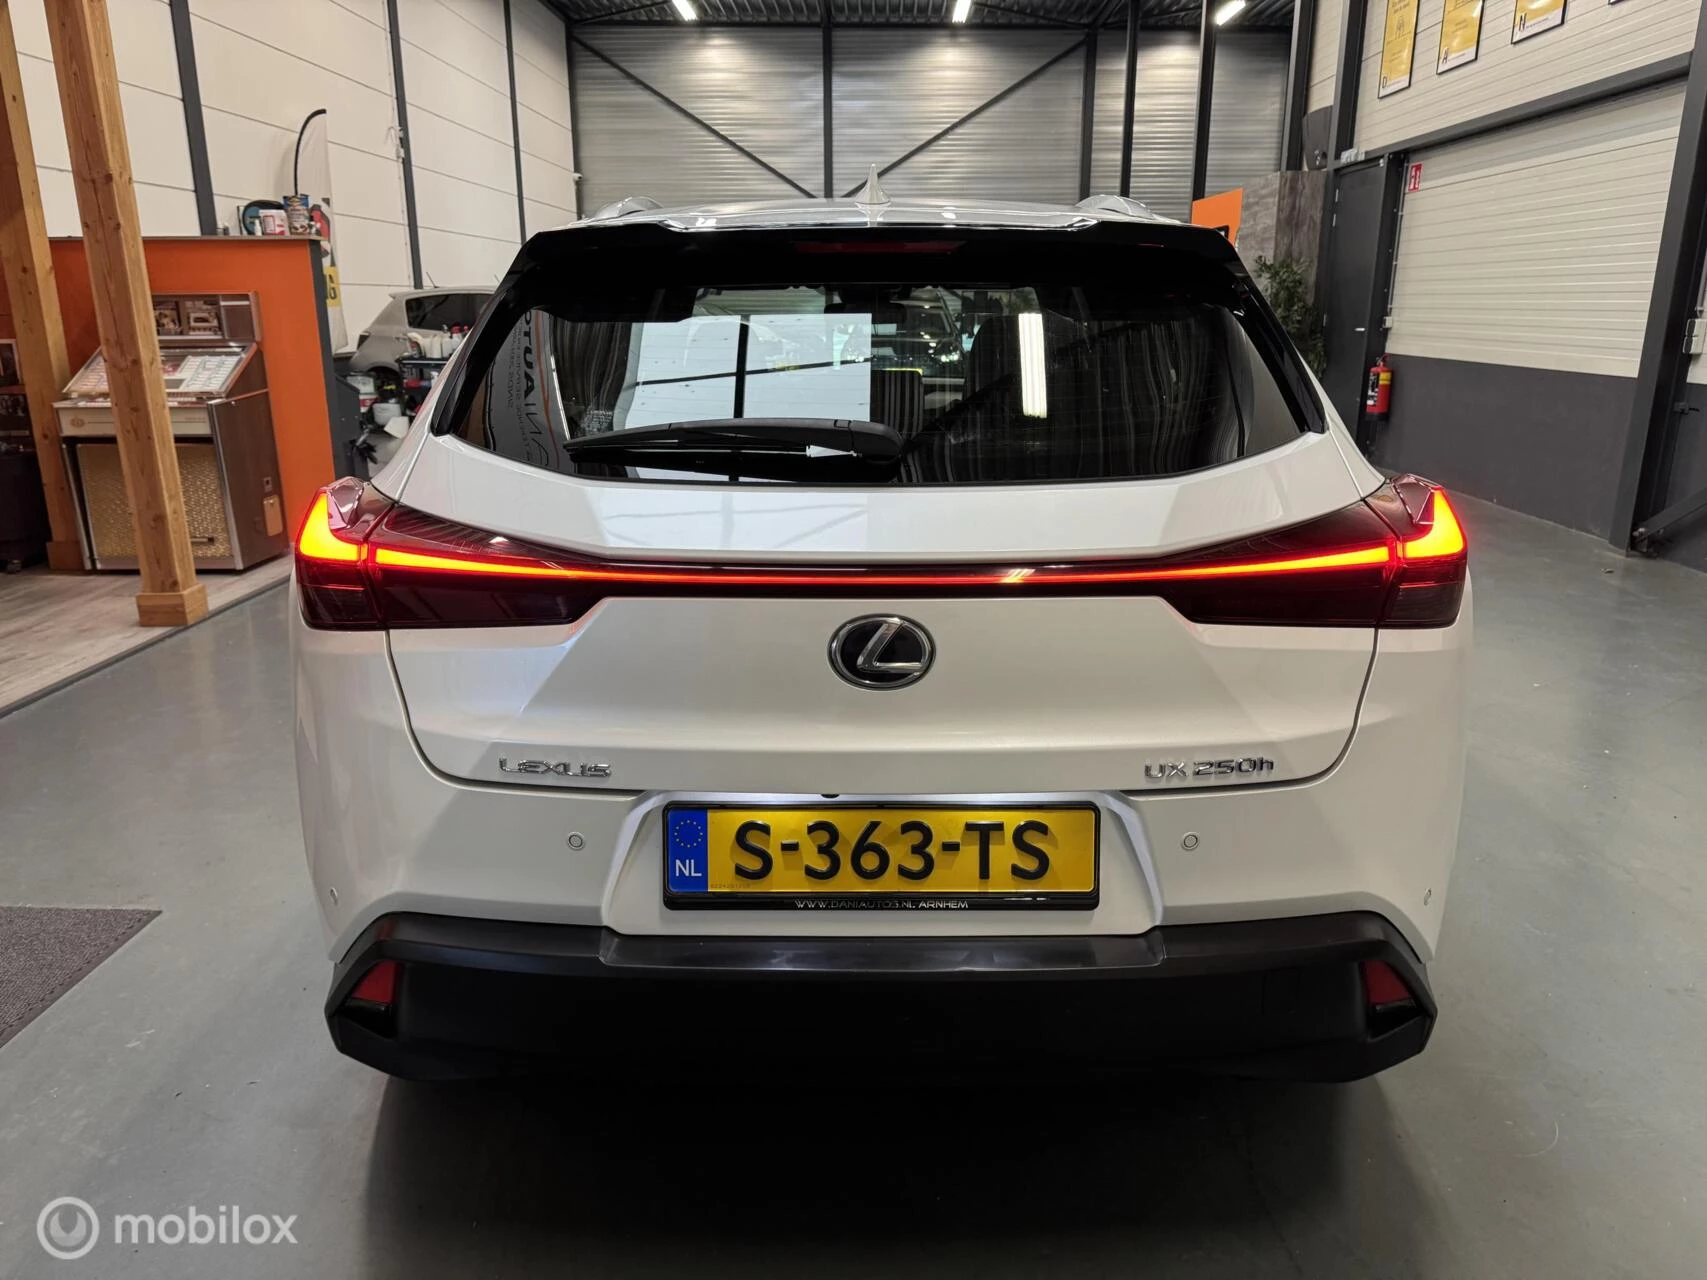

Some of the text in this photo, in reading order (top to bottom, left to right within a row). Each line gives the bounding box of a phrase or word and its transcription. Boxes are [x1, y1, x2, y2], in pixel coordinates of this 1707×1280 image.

[499, 758, 612, 777] LEXUS
[1144, 757, 1274, 778] UX 250h
[734, 820, 1050, 881] S-363-TS
[675, 859, 702, 877] NL
[918, 900, 969, 909] ARNHEM
